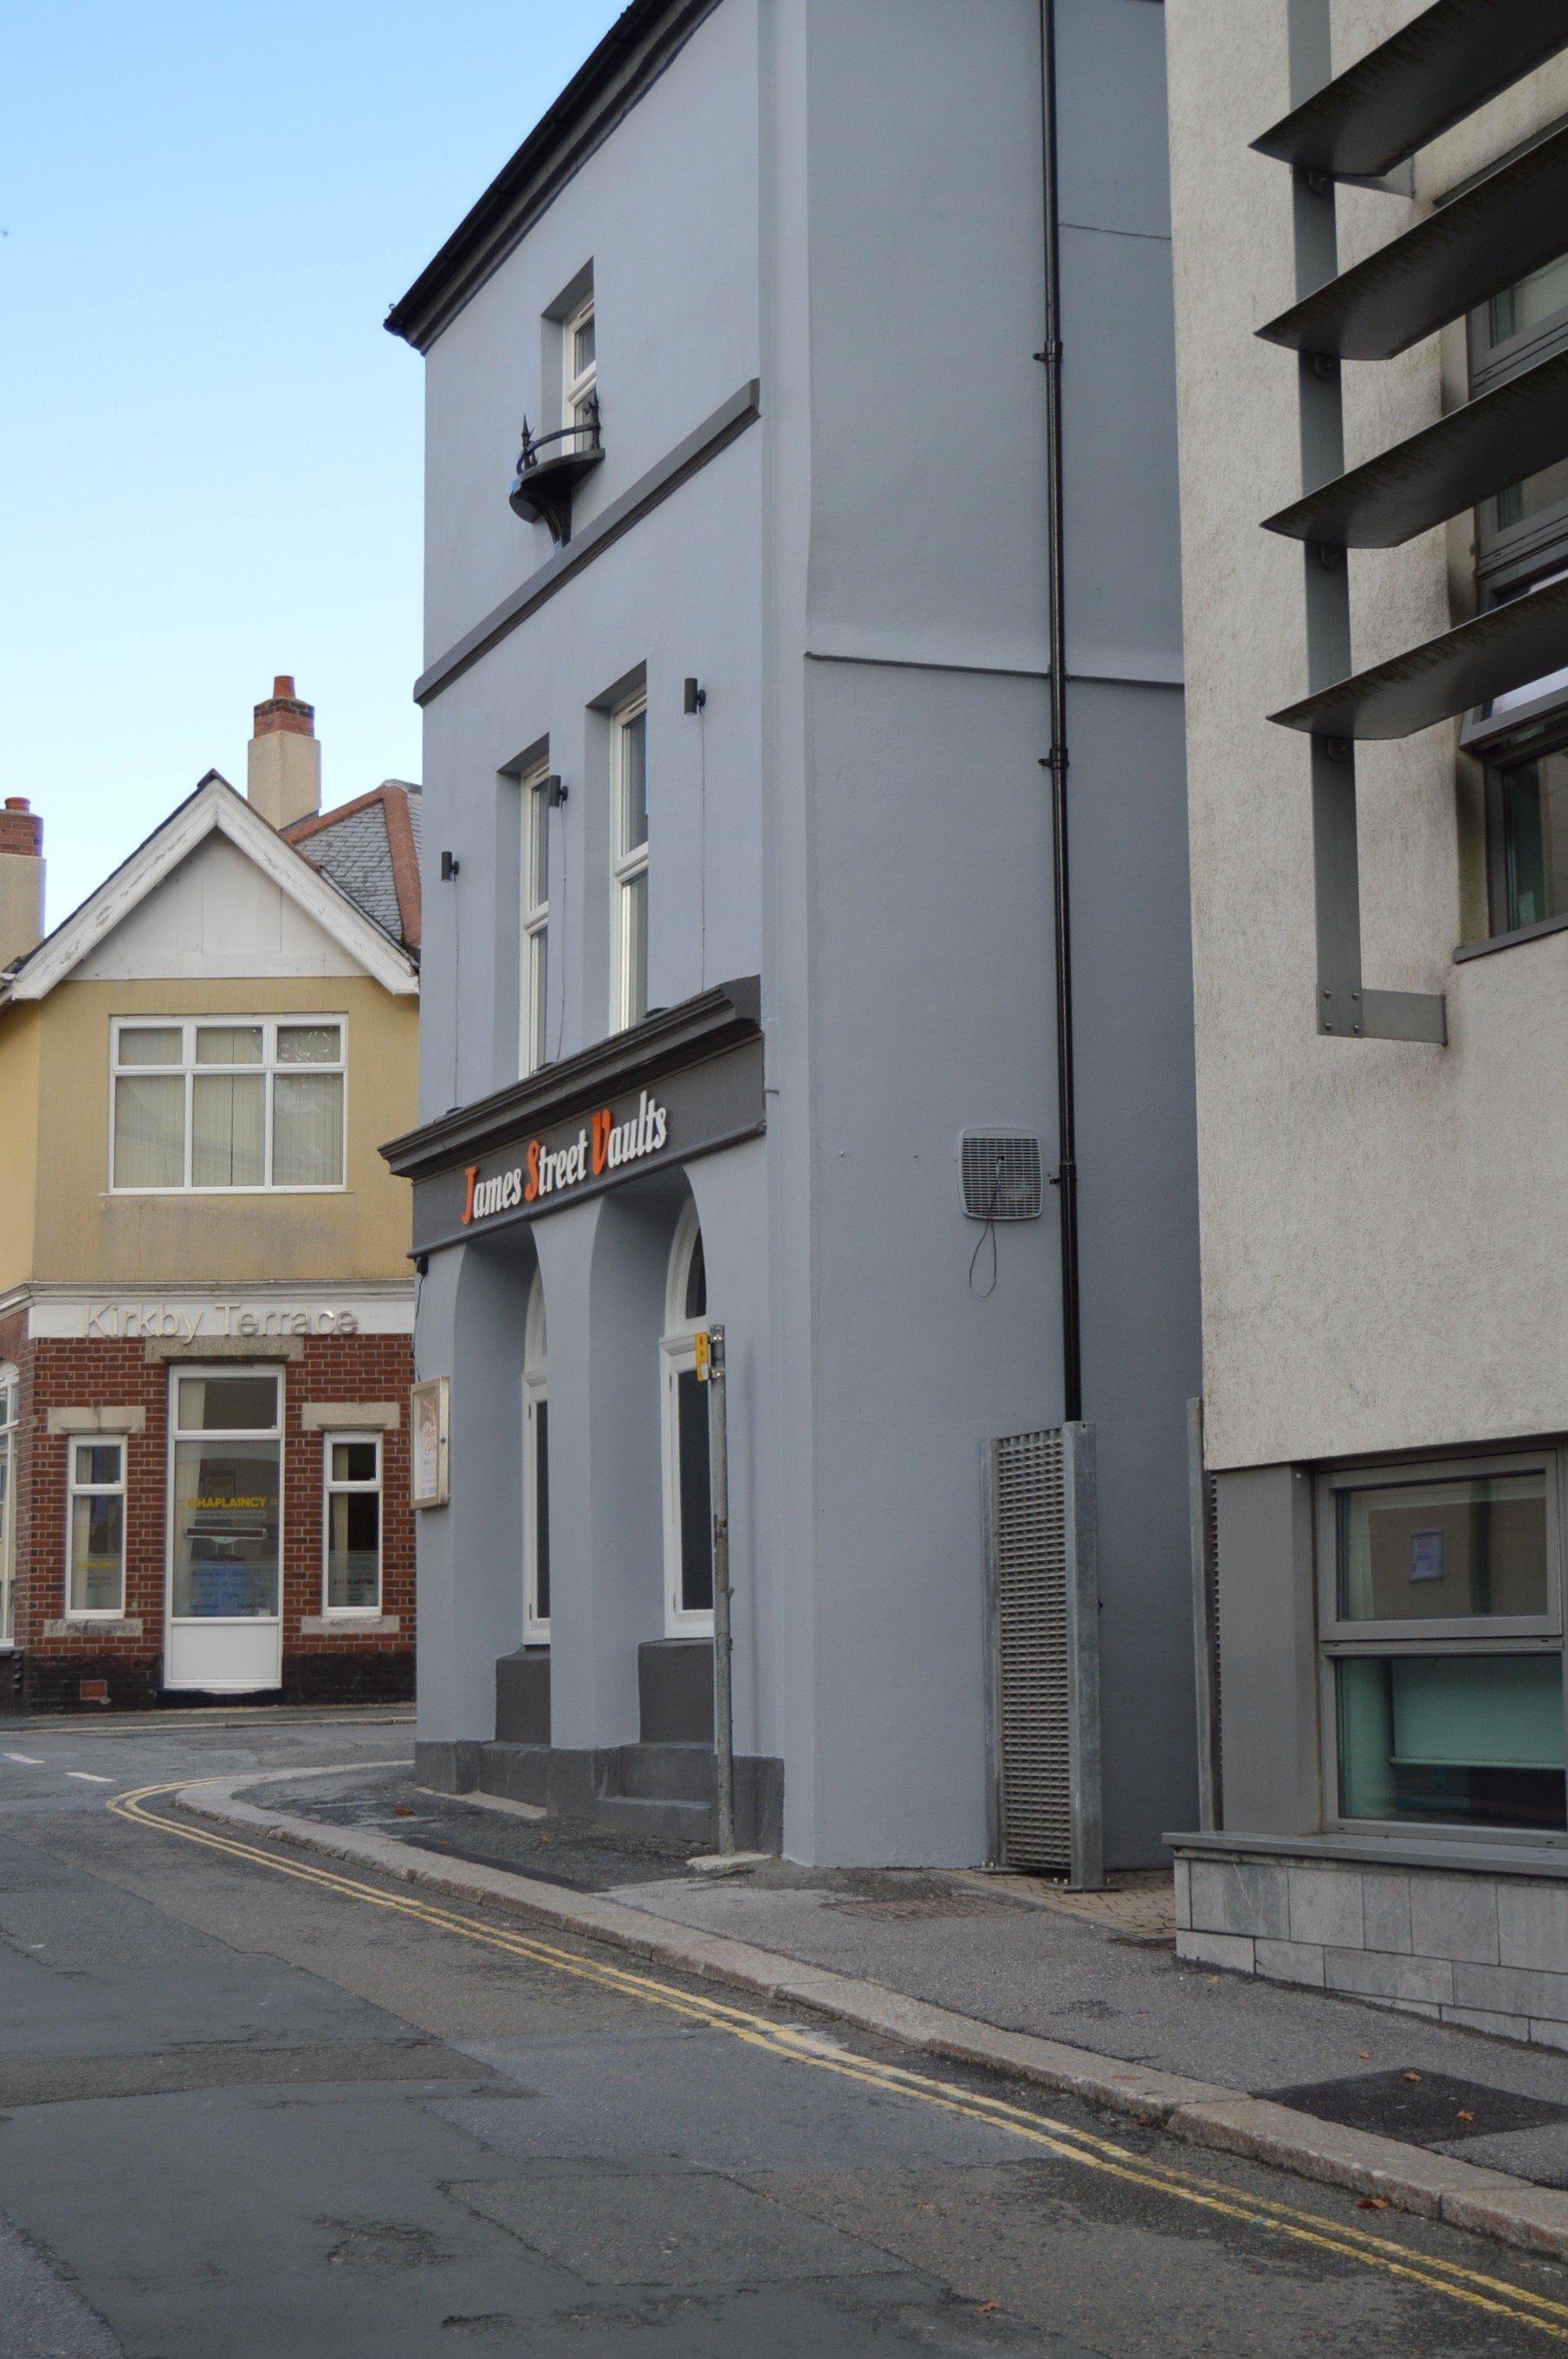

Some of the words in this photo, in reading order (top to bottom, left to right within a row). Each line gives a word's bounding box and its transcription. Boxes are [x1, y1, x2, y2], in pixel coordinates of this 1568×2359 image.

[461, 1165, 522, 1225] James
[525, 1128, 588, 1202] Street
[591, 1090, 667, 1176] Vaults
[86, 1303, 203, 1345] Kirkby
[215, 1303, 358, 1336] Terrace
